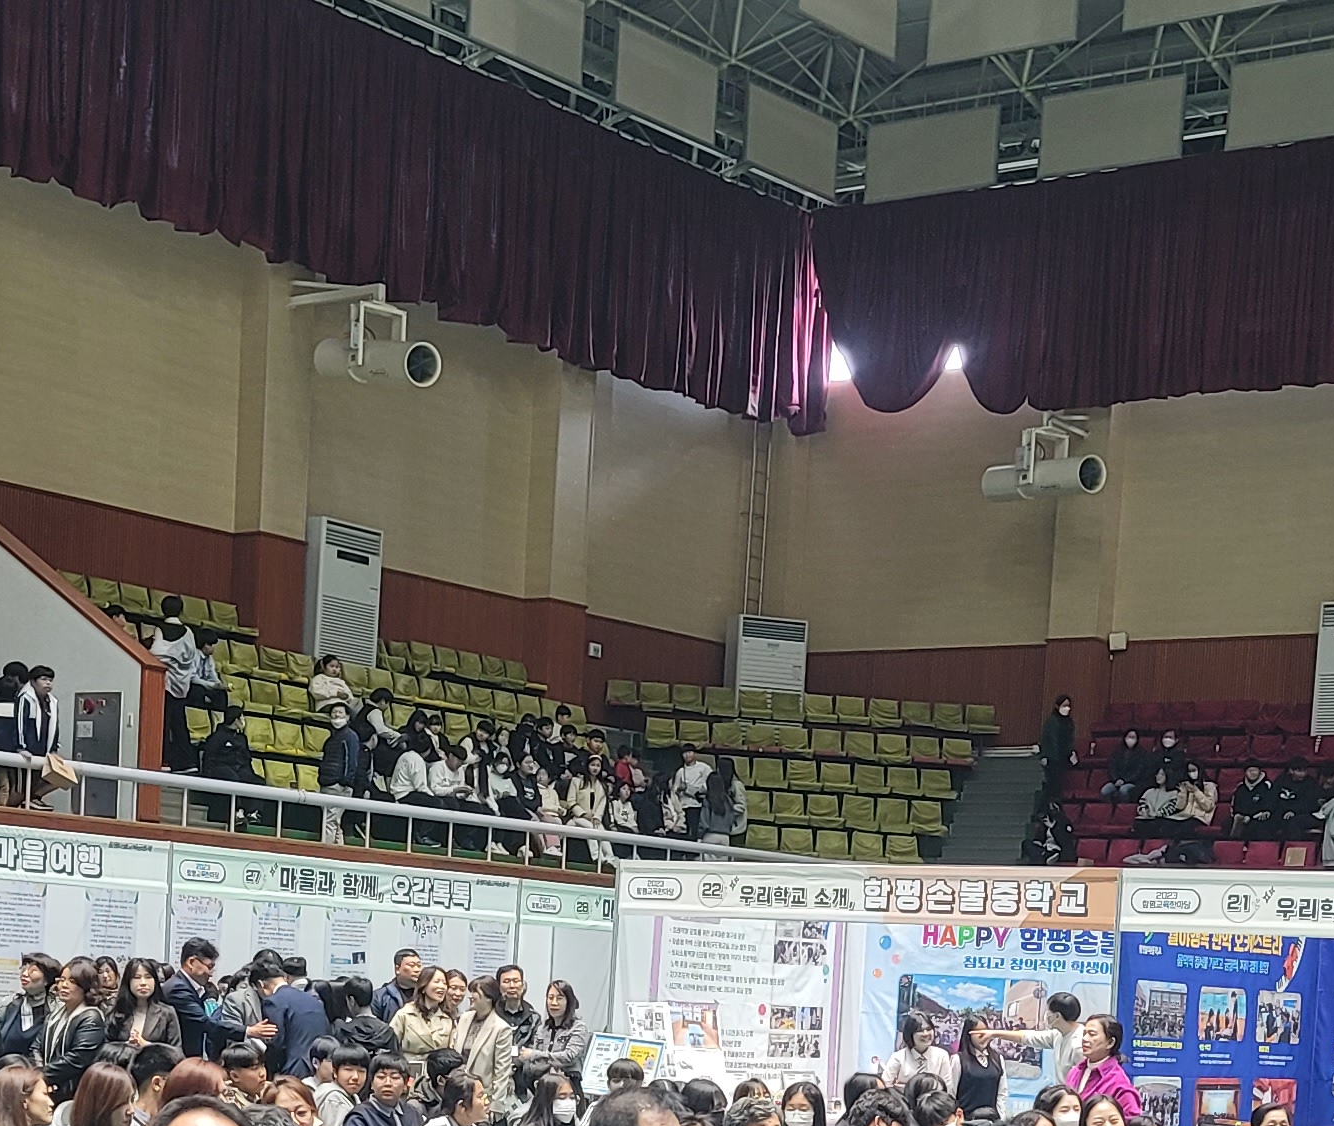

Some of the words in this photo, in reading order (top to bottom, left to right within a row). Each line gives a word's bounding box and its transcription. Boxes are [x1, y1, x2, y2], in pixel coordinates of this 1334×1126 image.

[244, 868, 263, 887] 27
[278, 866, 336, 896] 마을과
[341, 872, 384, 904] 함께,
[700, 883, 724, 899] 22
[739, 885, 807, 907] 우리학교
[814, 888, 854, 911] 소개,
[863, 876, 1090, 916] 함평손불중학교
[1155, 891, 1179, 900] 2023
[576, 901, 589, 915] 28
[1226, 893, 1251, 912] 21
[922, 923, 1010, 949] HAPPY
[962, 954, 1005, 970] 참되고
[1009, 957, 1067, 973] 창의적인
